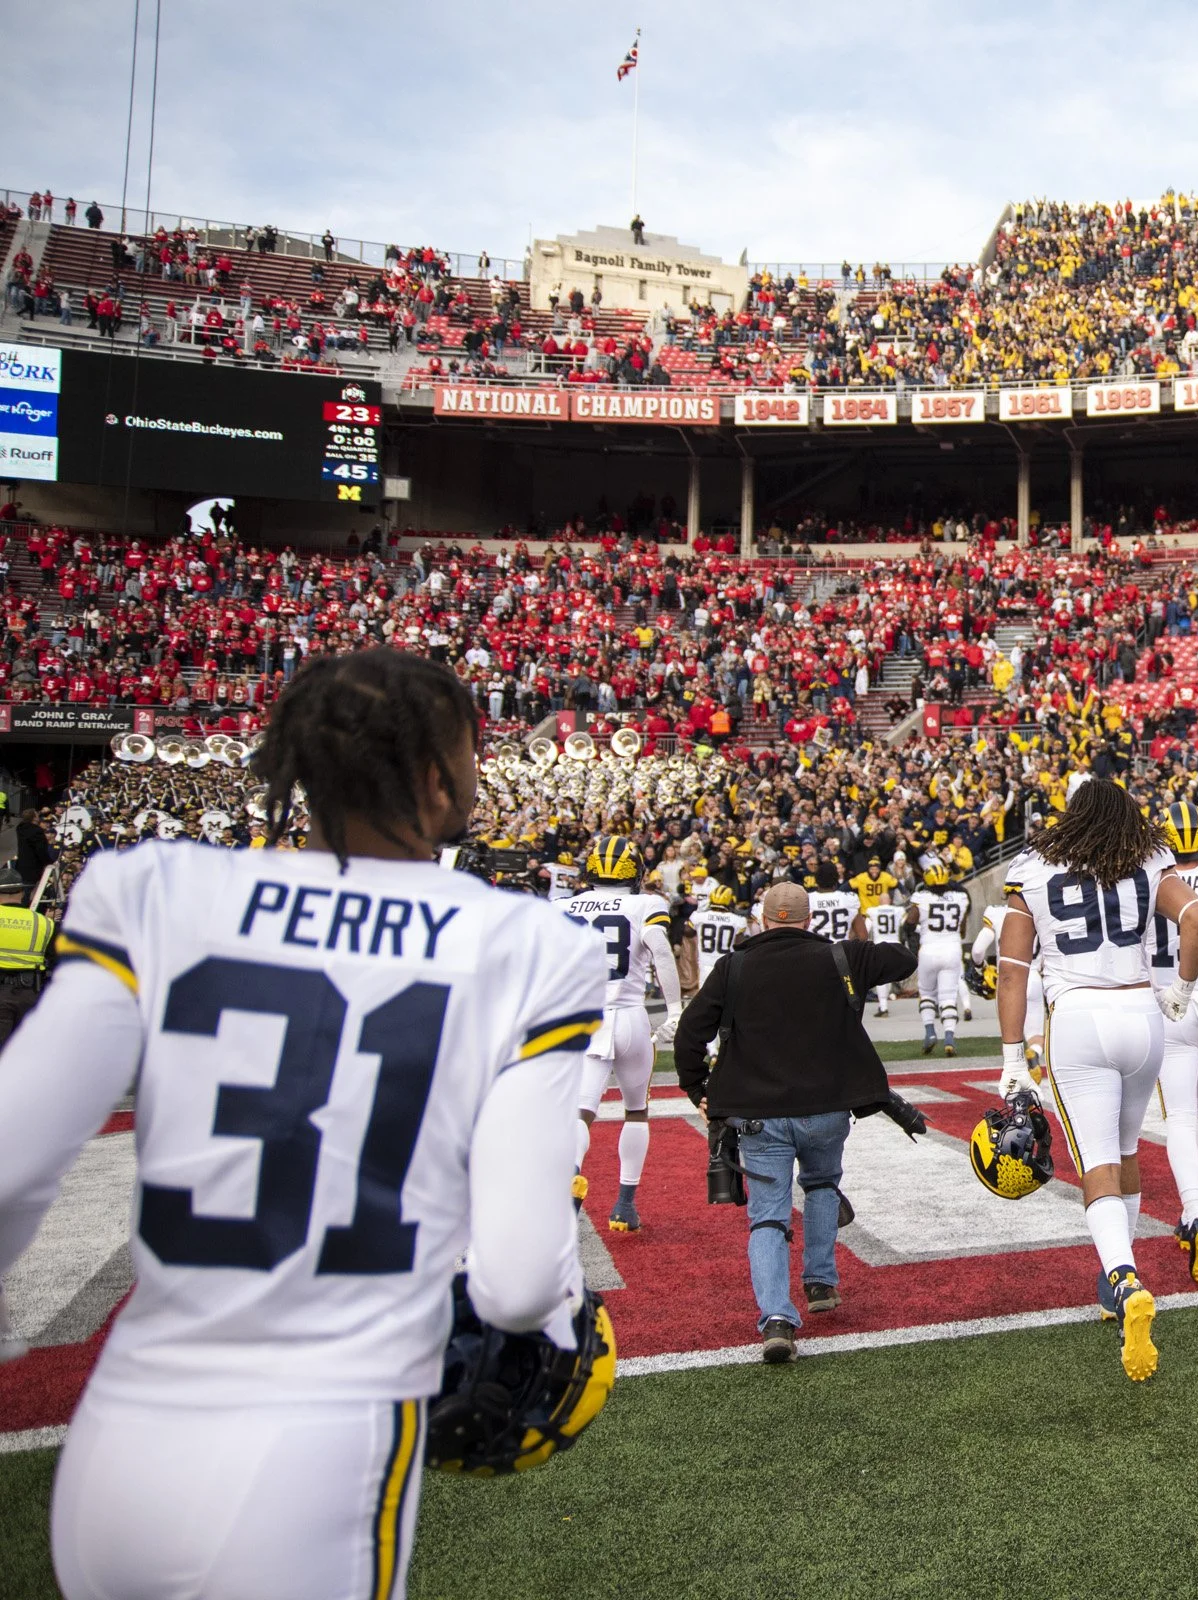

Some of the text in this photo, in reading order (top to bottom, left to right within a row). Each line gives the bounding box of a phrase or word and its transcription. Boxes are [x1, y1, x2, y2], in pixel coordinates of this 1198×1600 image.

[574, 250, 712, 279] Bagnoli Family Tower
[441, 389, 714, 421] NATIONAL CHAMPIONS
[743, 400, 801, 421] 1942
[831, 399, 888, 420] 1954
[920, 397, 976, 419] 1957
[1008, 394, 1062, 415] 1961
[1095, 390, 1152, 411] 1968
[11, 401, 53, 422] Kroger
[335, 405, 370, 422] 23
[125, 415, 283, 440] OhioStateBuckeyes.com
[328, 424, 351, 434] 4th
[10, 447, 53, 461] Ruoff
[340, 445, 378, 454] QUARTER
[358, 453, 377, 463] 35
[333, 464, 369, 480] 45
[337, 484, 362, 501] M
[75, 682, 85, 691] 15
[31, 711, 113, 720] JOHN C. GRAY
[45, 720, 75, 728] RAMP
[78, 721, 131, 730] ENTRANCE
[165, 826, 176, 834] M
[207, 820, 222, 831] M
[60, 832, 73, 841] M
[866, 883, 882, 896] 90
[568, 898, 622, 914] STOKES
[817, 899, 840, 909] BENNY
[1047, 866, 1150, 956] 90
[238, 879, 460, 960] PERRY
[811, 908, 849, 940] 26
[878, 914, 896, 934] 91
[928, 903, 960, 932] 53
[563, 914, 631, 980] 3
[701, 923, 735, 954] 80
[138, 955, 452, 1276] 31
